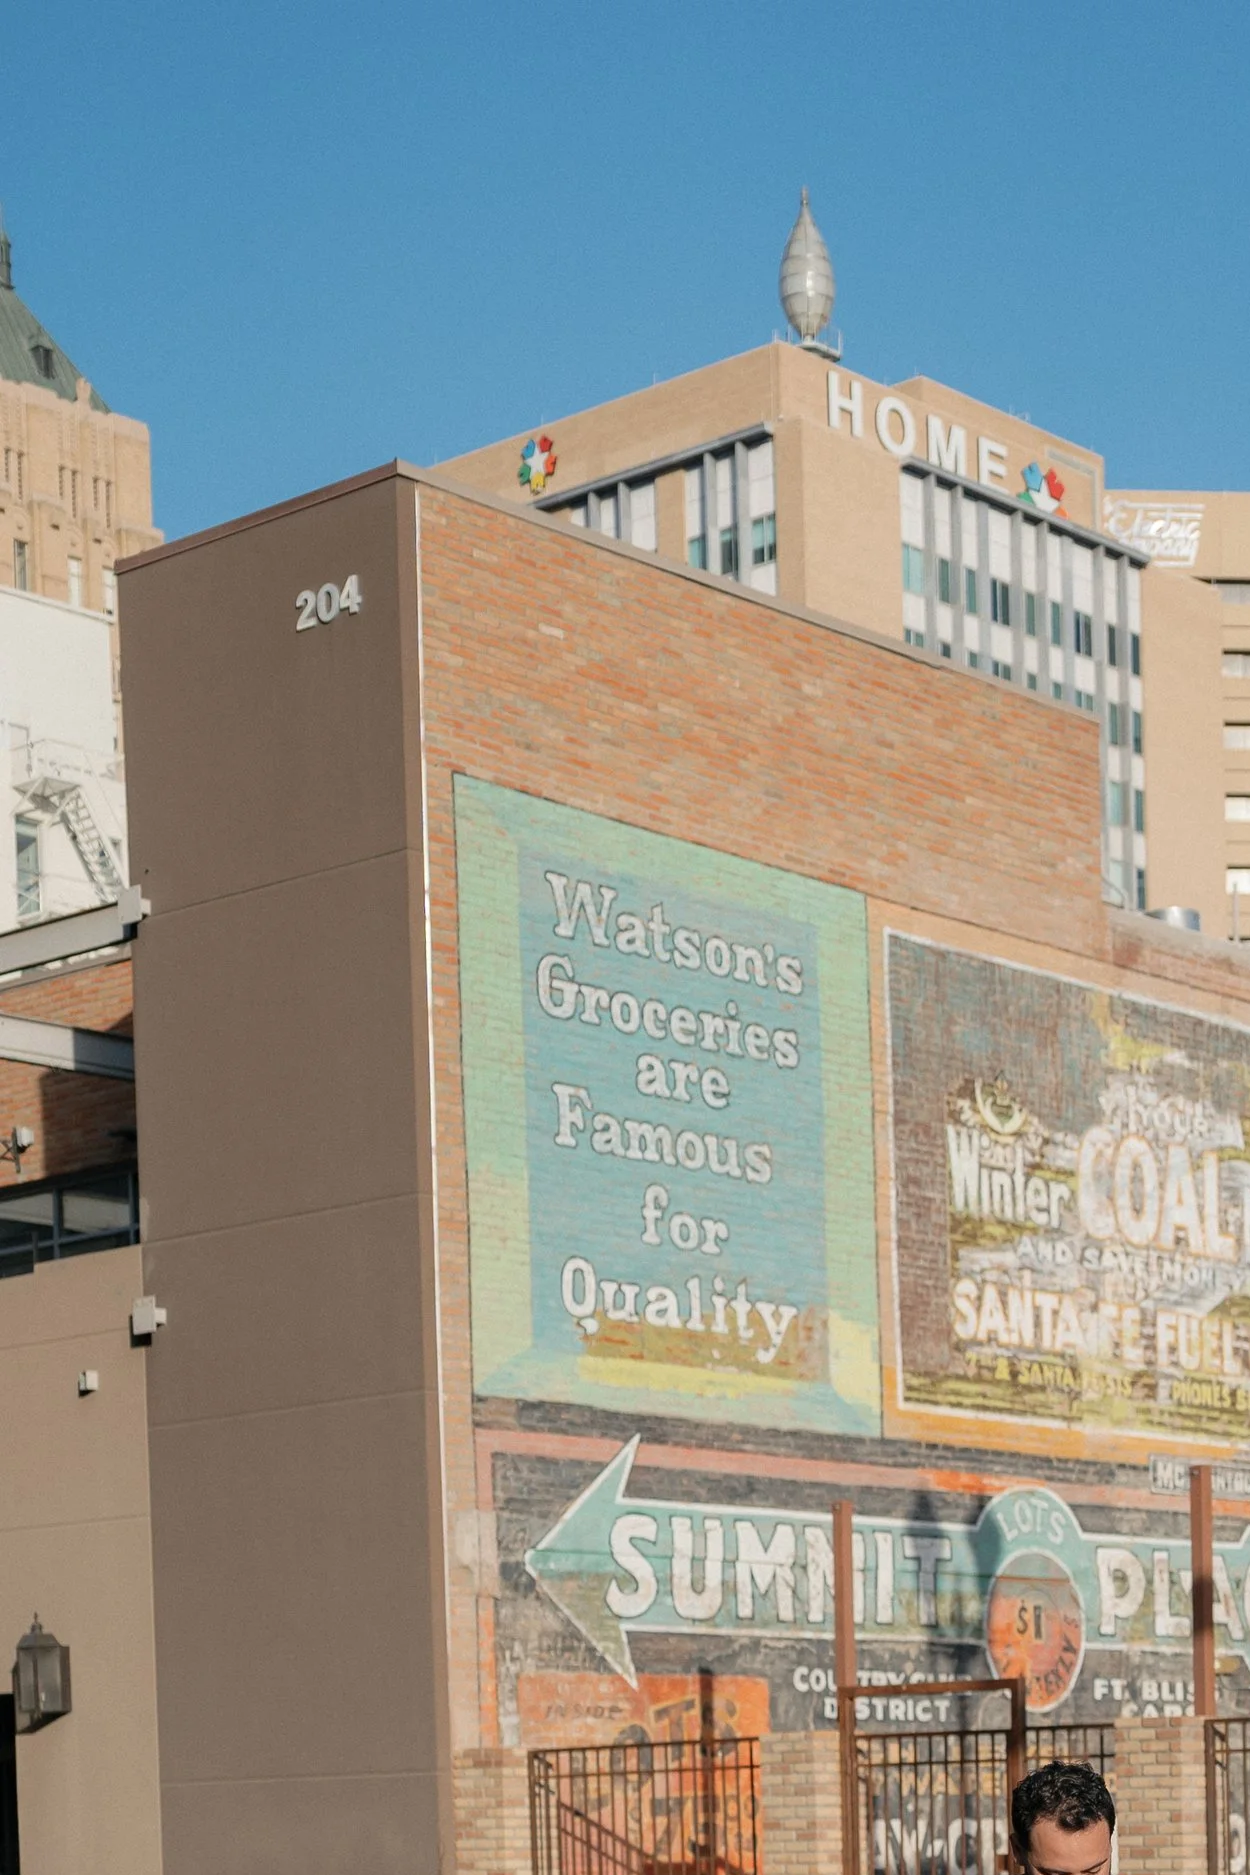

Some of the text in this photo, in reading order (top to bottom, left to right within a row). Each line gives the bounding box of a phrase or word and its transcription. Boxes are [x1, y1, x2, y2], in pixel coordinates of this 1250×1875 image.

[827, 370, 1010, 495] HOME
[296, 574, 362, 632] 204
[545, 871, 804, 996] Watson's
[536, 955, 800, 1069] Groceries
[636, 1053, 731, 1110] are
[552, 1082, 773, 1184] Famous
[641, 1183, 729, 1256] for
[946, 1124, 1070, 1231] Winter
[1077, 1127, 1237, 1264] COAL
[561, 1256, 798, 1363] Quality
[953, 1277, 1086, 1356] SANTA
[1156, 1308, 1243, 1377] FUEL
[606, 1513, 953, 1627] SUMMIT
[996, 1498, 1047, 1545] LOTS
[793, 1666, 906, 1692] COUTRY
[824, 1696, 950, 1722] DSTRICT
